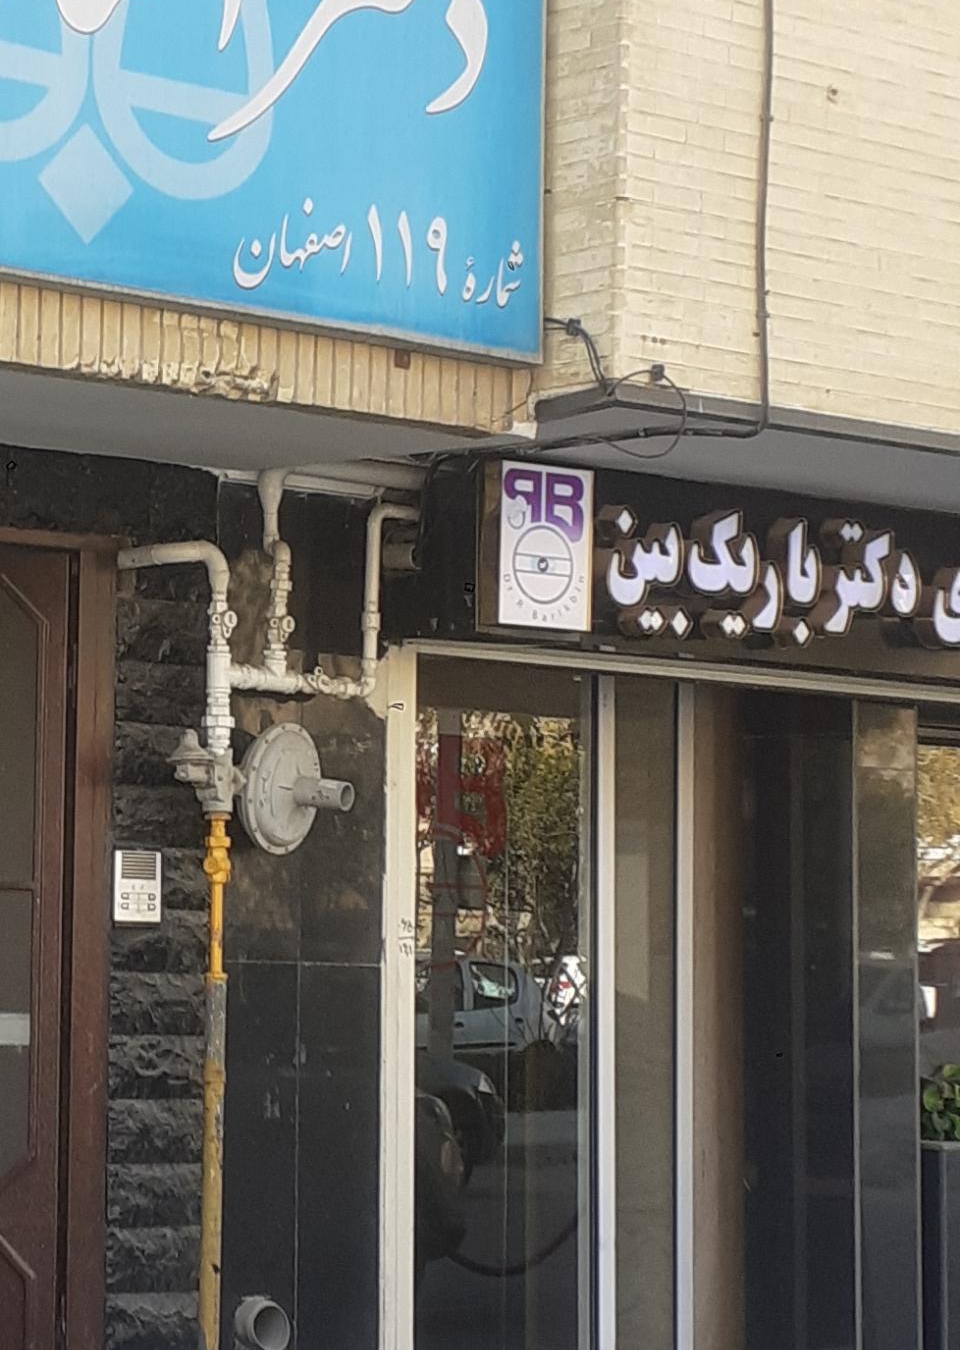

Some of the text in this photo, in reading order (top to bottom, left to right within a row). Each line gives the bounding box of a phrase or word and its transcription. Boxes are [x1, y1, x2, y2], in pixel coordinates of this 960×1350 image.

[232, 197, 352, 289] اصفهان
[367, 203, 448, 295] ۱۱۹
[607, 509, 689, 636] بین
[688, 509, 823, 646] باریک
[824, 520, 919, 634] دکتر
